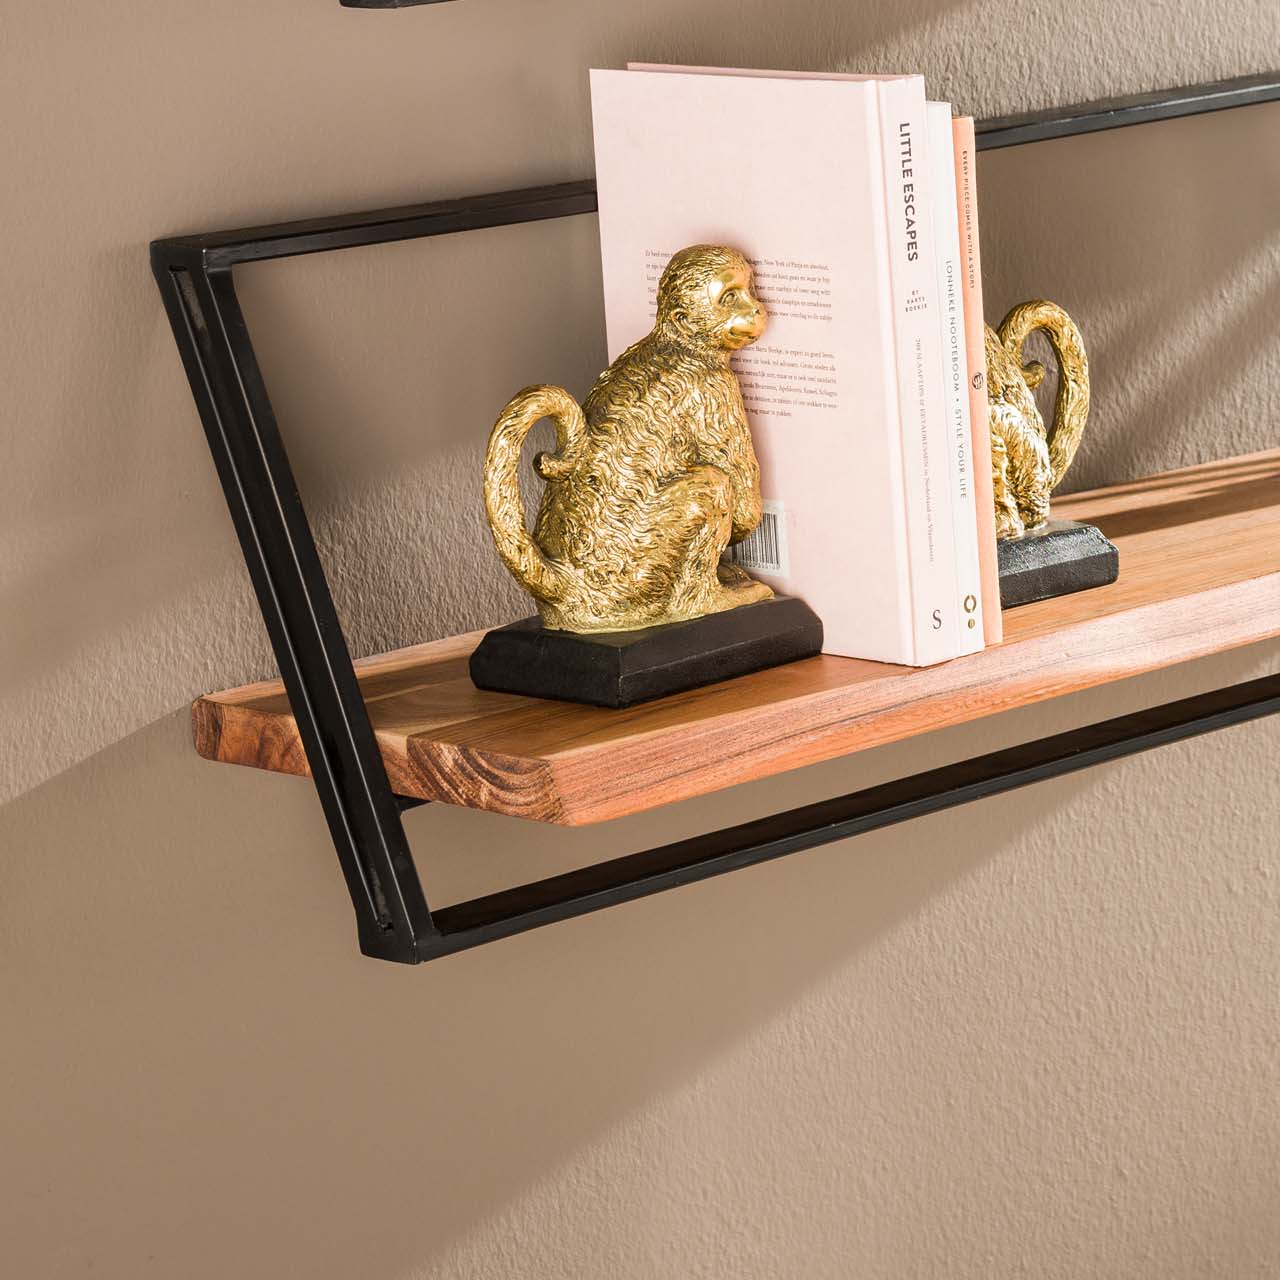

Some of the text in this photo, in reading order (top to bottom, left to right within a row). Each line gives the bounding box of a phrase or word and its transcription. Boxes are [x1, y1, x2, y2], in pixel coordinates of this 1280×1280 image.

[899, 122, 918, 262] LITTLE ESCAPES
[945, 260, 956, 313] LONNEKE
[949, 316, 960, 392] NOOTEBOOM
[955, 408, 963, 439] STYLE
[932, 609, 942, 630] S
